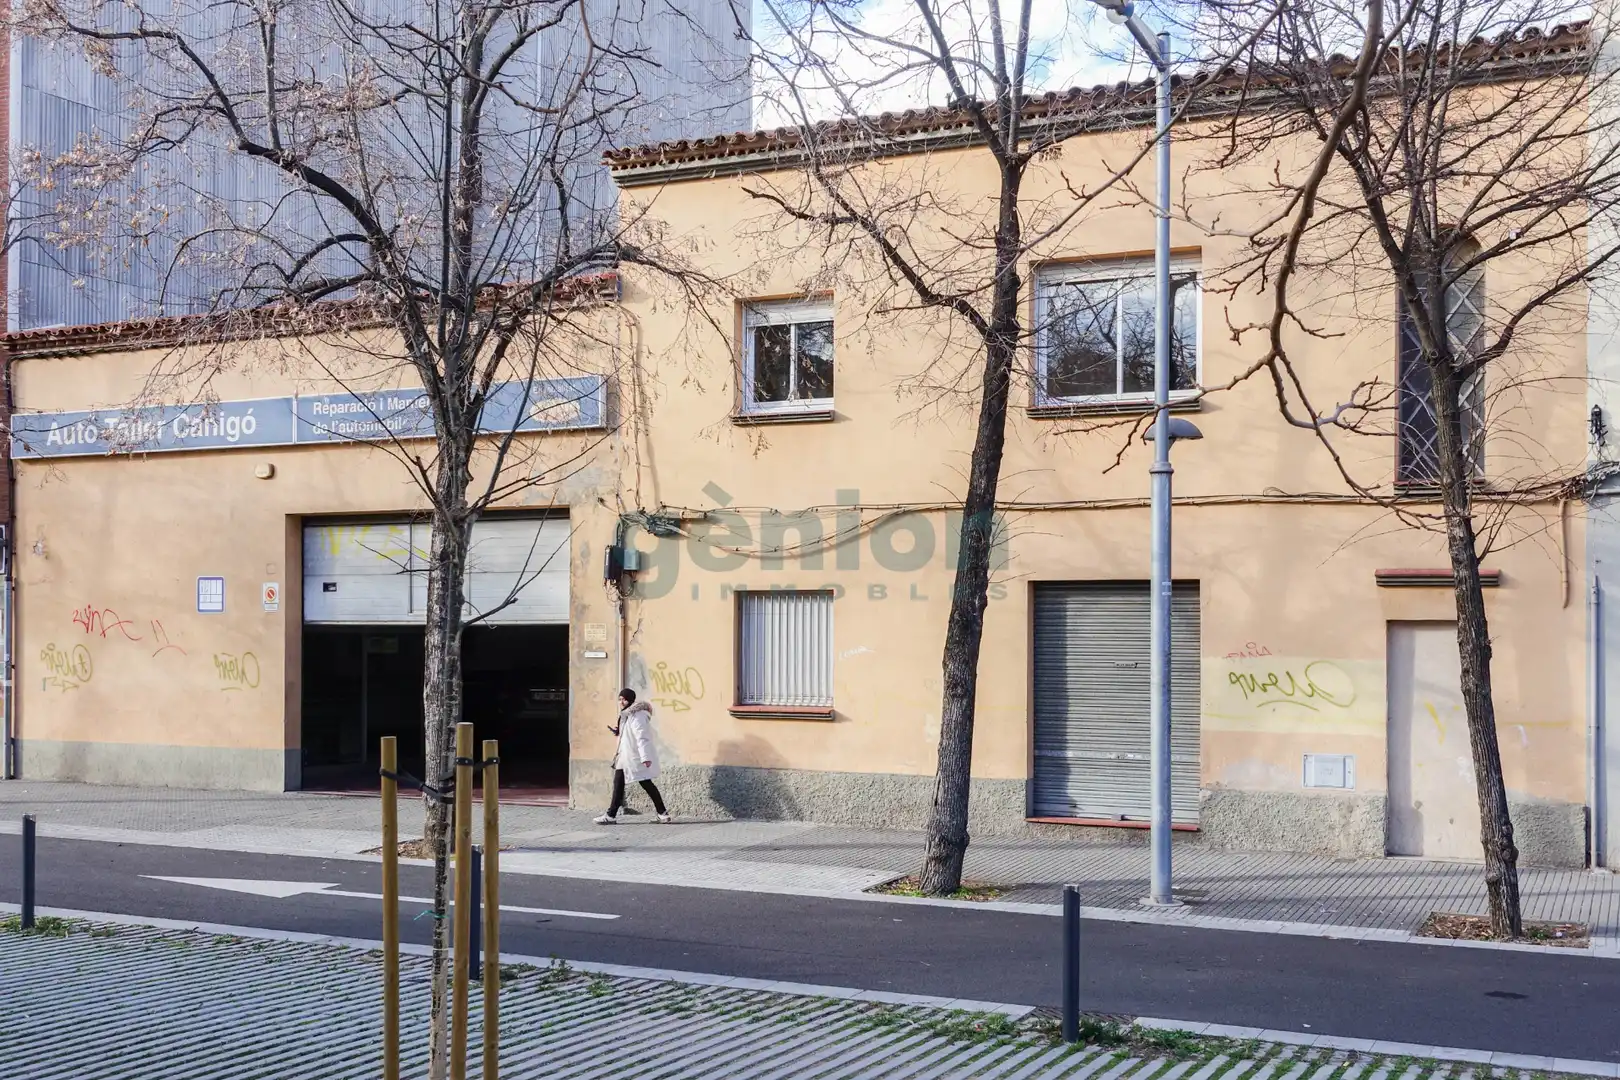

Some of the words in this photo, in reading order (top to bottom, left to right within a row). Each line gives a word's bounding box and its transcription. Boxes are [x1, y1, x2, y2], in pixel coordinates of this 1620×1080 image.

[313, 398, 376, 417] Reparació
[47, 421, 98, 446] Auto
[173, 408, 256, 442] Canigó
[313, 422, 328, 434] de
